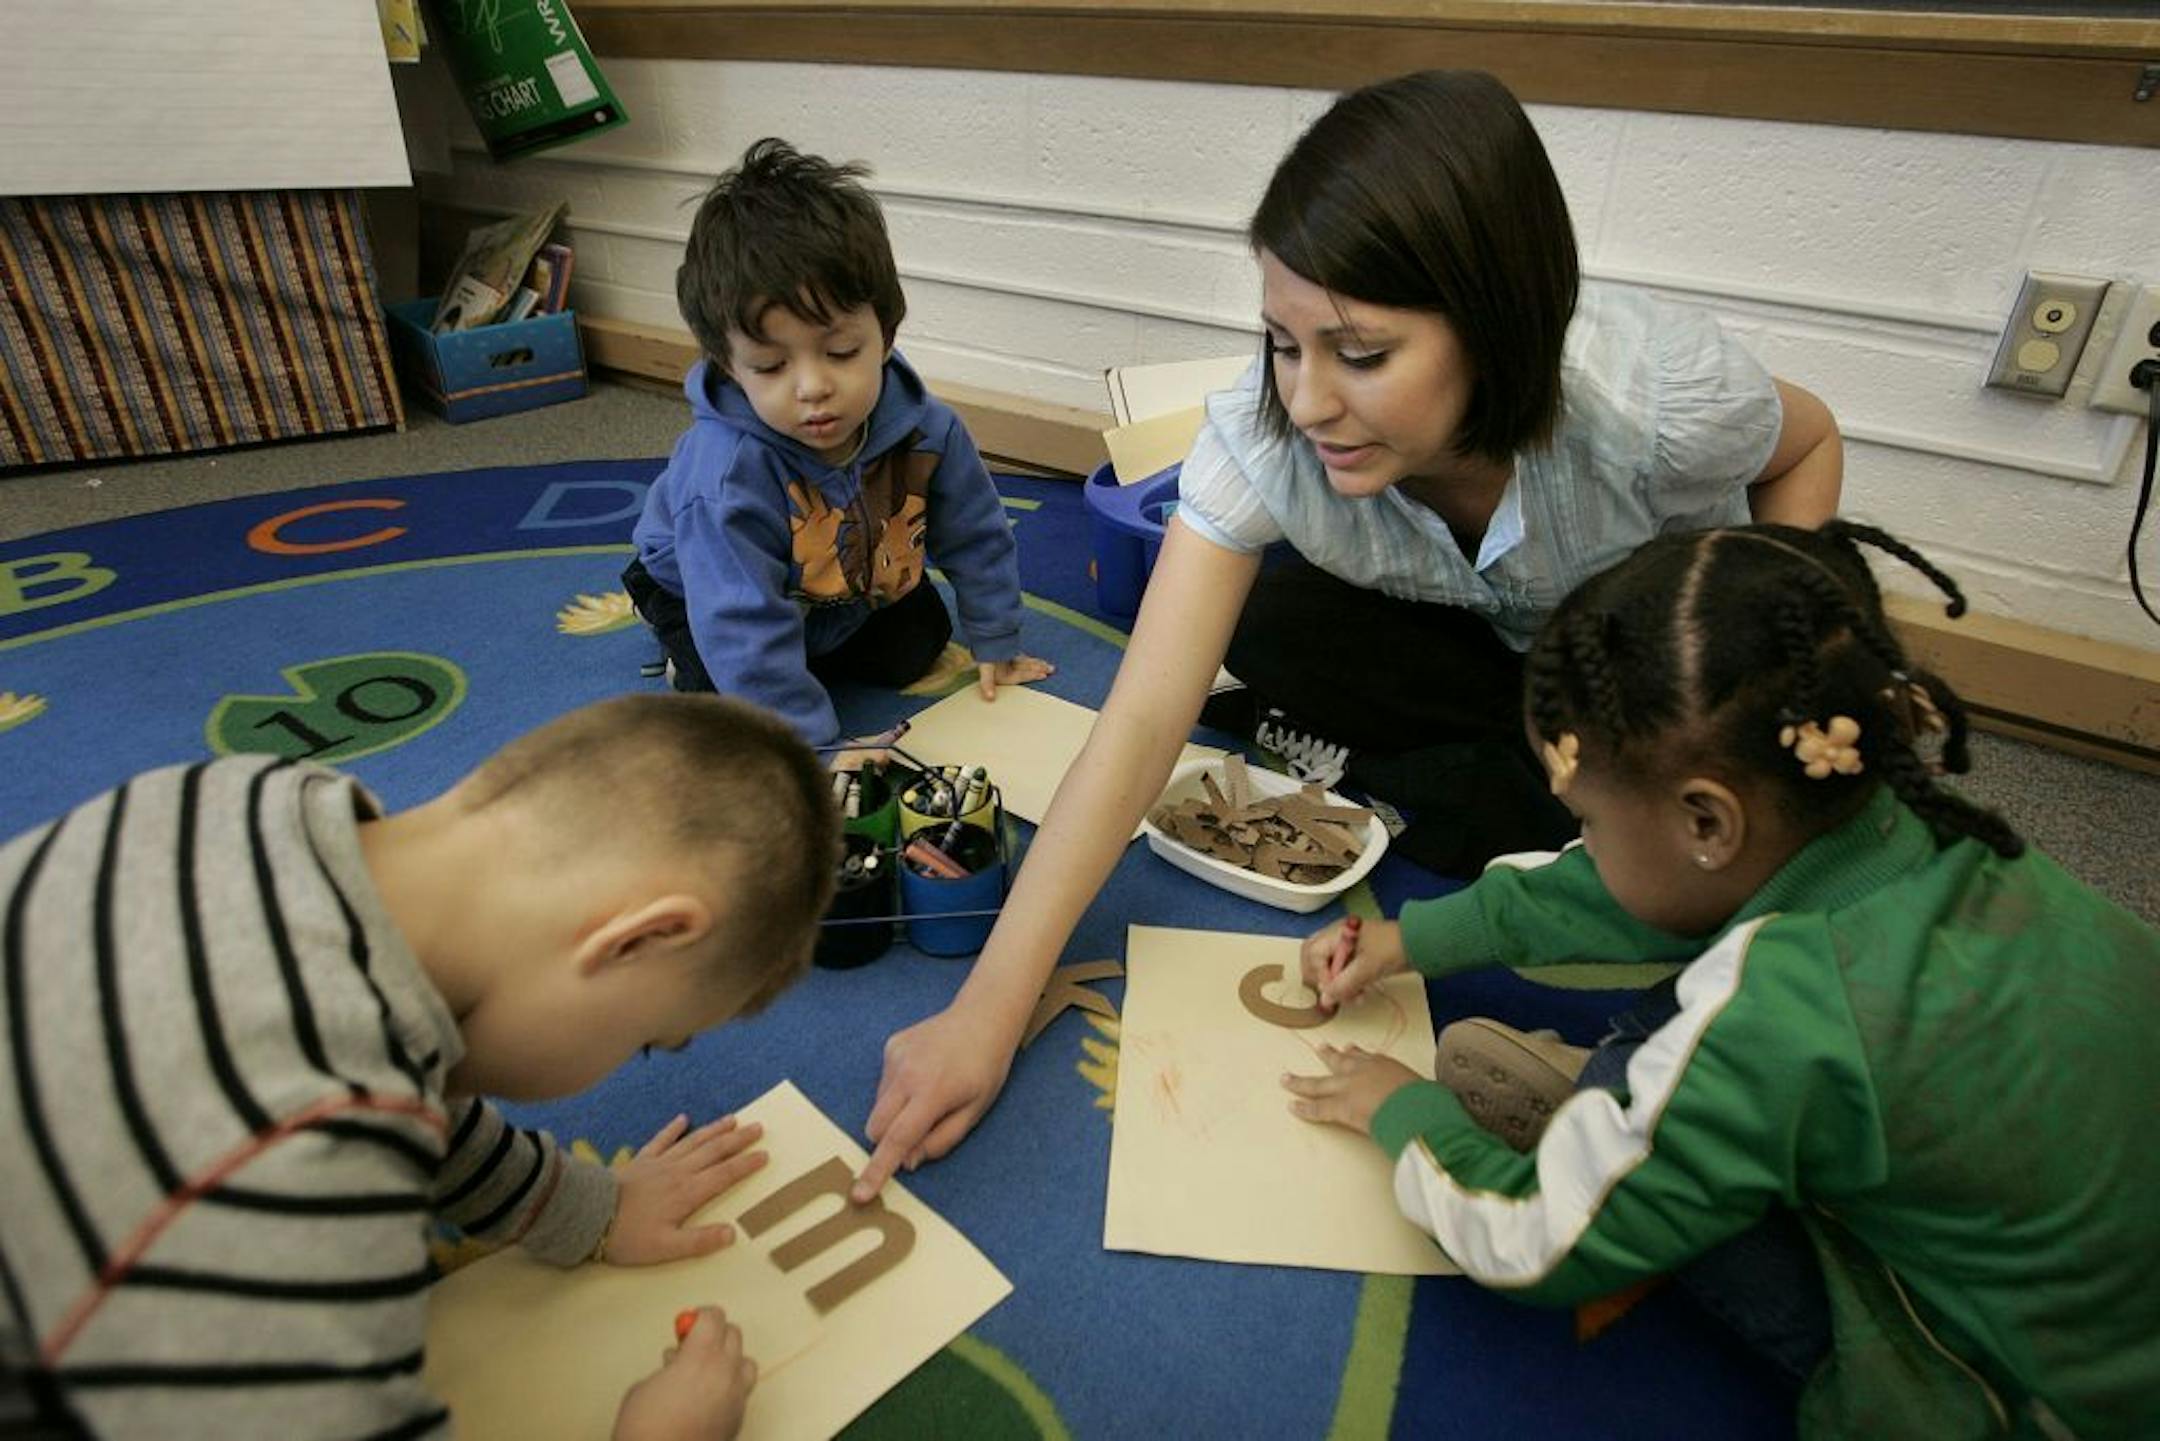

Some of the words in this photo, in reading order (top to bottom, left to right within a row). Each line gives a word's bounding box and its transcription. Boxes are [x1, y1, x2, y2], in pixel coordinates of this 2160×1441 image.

[490, 77, 542, 117] CHART
[0, 551, 118, 617] B
[246, 499, 407, 556] C
[516, 480, 650, 530] D
[253, 675, 437, 760] 10
[735, 1155, 917, 1318] m
